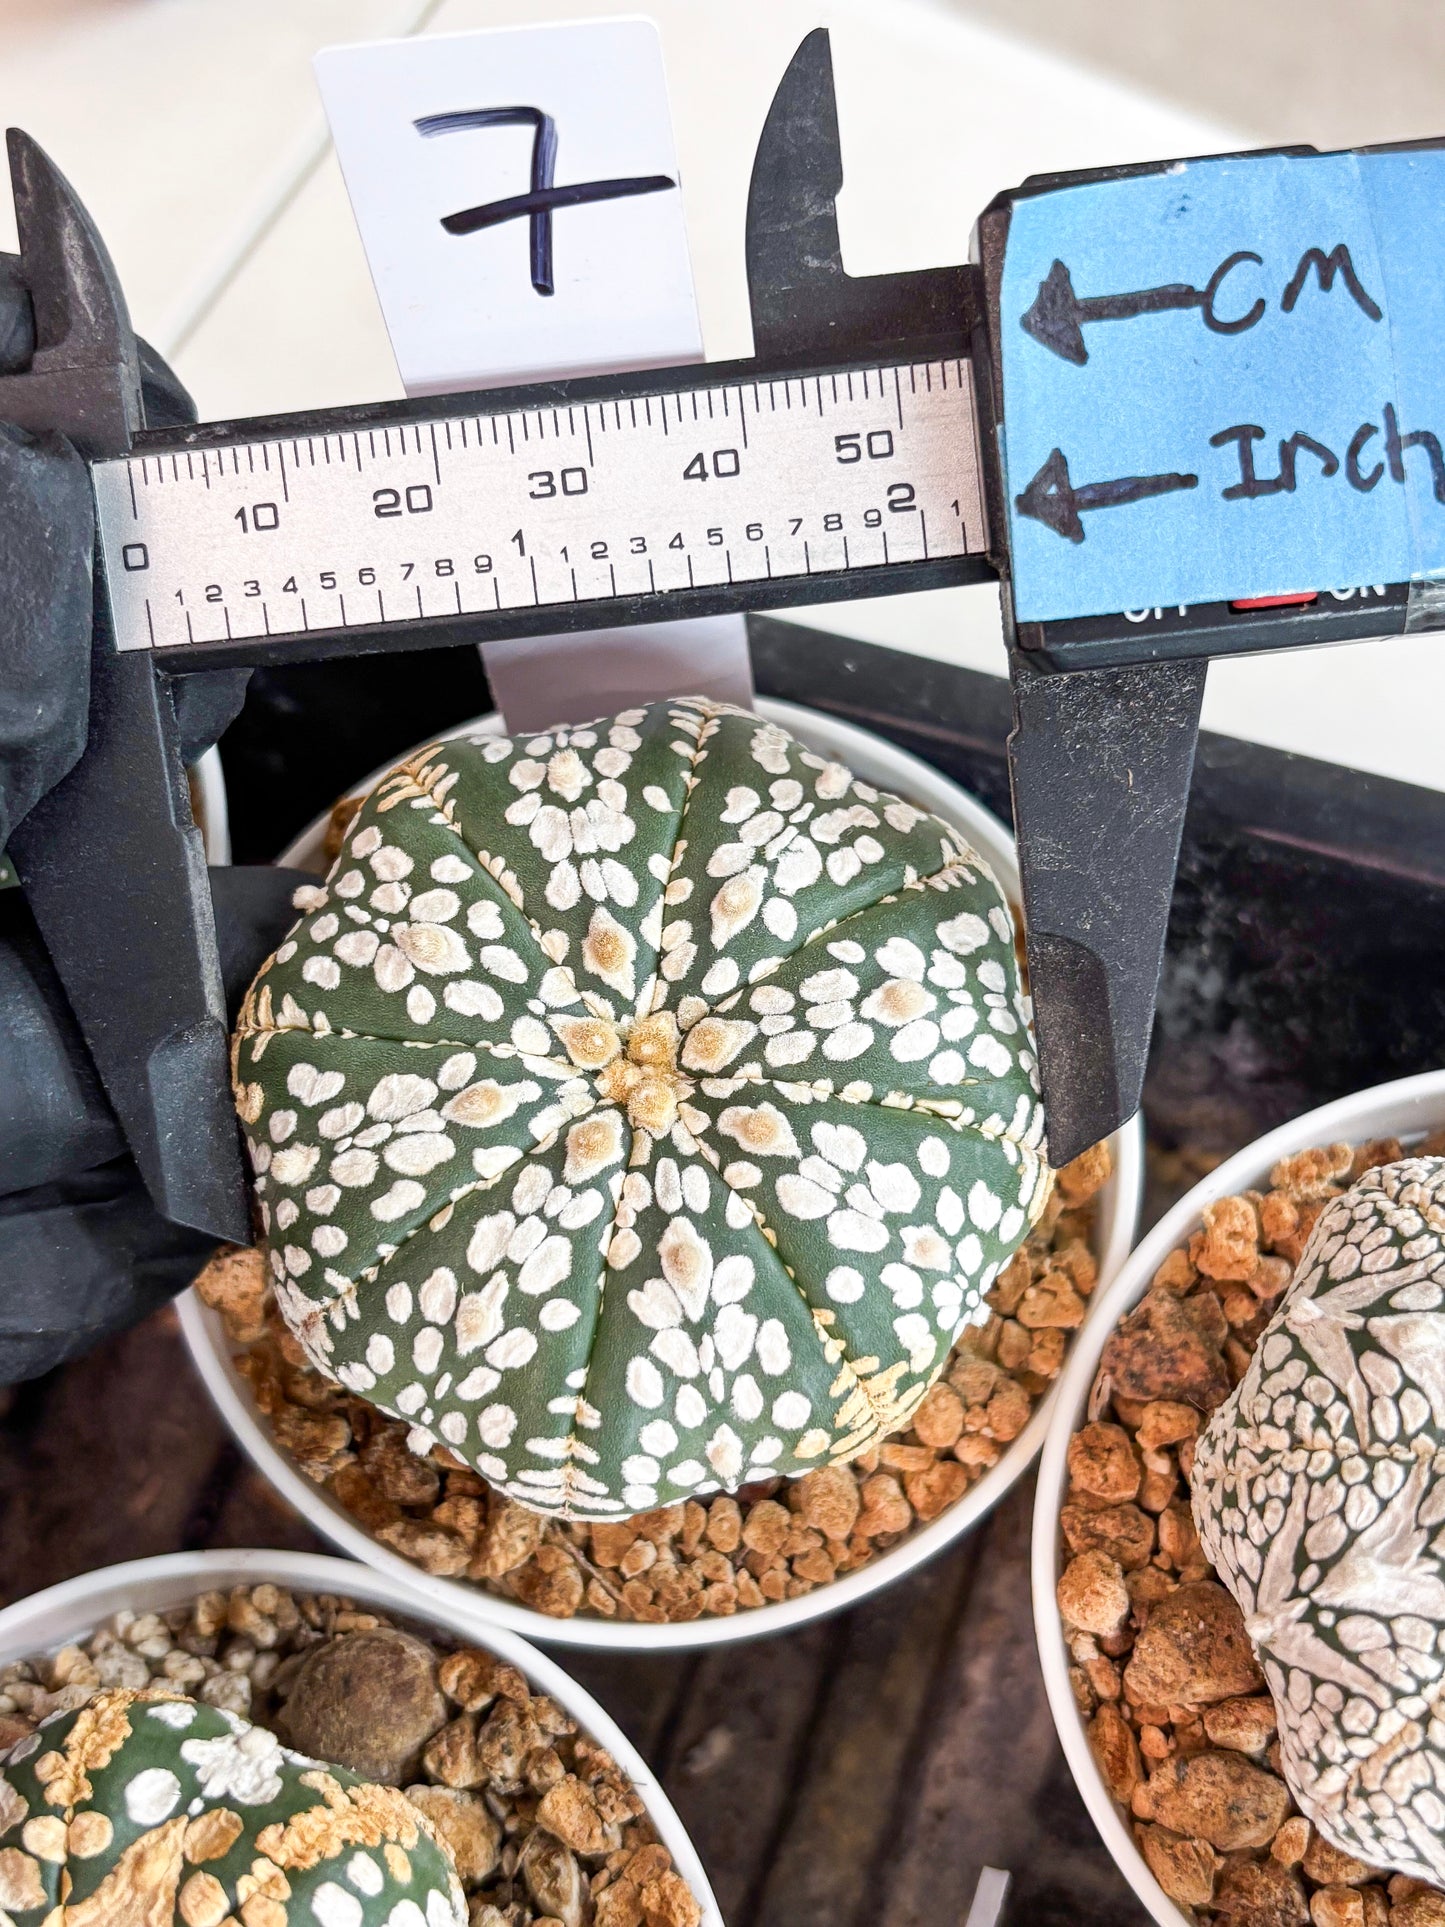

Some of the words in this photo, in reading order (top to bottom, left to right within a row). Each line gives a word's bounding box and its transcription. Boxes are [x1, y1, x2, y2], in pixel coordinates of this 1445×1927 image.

[413, 105, 677, 297] 7
[121, 542, 150, 573] 0
[234, 502, 279, 534] 10
[372, 484, 433, 519] 20
[527, 467, 588, 499] 30
[682, 448, 741, 482] 40
[834, 429, 894, 464] 50
[1209, 402, 1445, 506] Inch
[174, 587, 185, 606] 1
[205, 584, 223, 603] 2
[243, 579, 262, 598] 3
[282, 576, 299, 594] 4
[319, 571, 337, 590] 5
[358, 567, 376, 586] 6
[400, 562, 416, 581] 7
[434, 558, 455, 577] 8
[474, 554, 493, 574] 9
[510, 528, 526, 557] 1
[559, 545, 570, 563] 1
[590, 541, 609, 560] 2
[629, 536, 647, 554] 3
[668, 532, 685, 550] 4
[706, 527, 724, 546] 5
[745, 522, 764, 542] 6
[788, 517, 804, 536] 7
[823, 513, 843, 532] 8
[863, 508, 882, 528] 9
[886, 482, 917, 513] 2
[949, 499, 960, 517] 1
